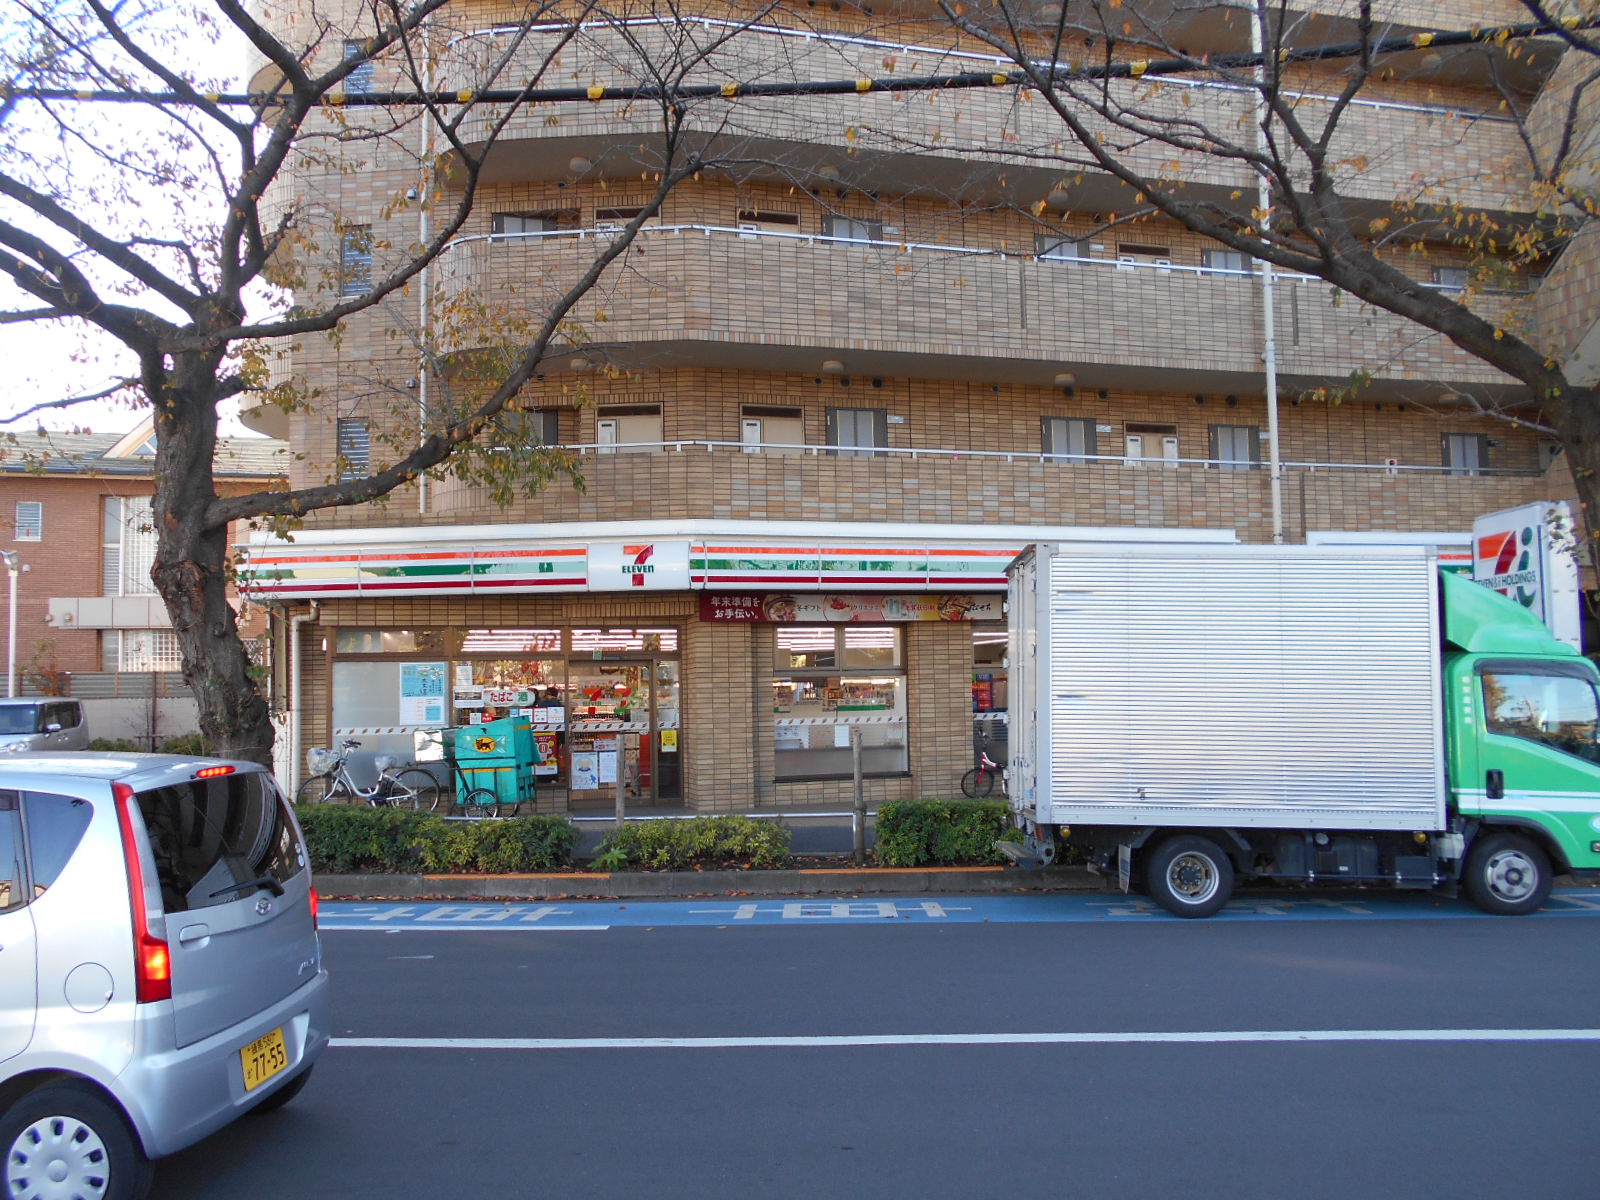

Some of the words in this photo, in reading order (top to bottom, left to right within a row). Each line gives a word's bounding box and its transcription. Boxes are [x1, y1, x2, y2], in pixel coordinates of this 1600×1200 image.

[1502, 571, 1536, 586] HOLDINGS
[711, 596, 760, 607] 年末準備を
[715, 609, 759, 619] お手伝い。
[490, 692, 513, 702] たばこ
[518, 692, 529, 702] 酒
[252, 1042, 285, 1081] 77-55
